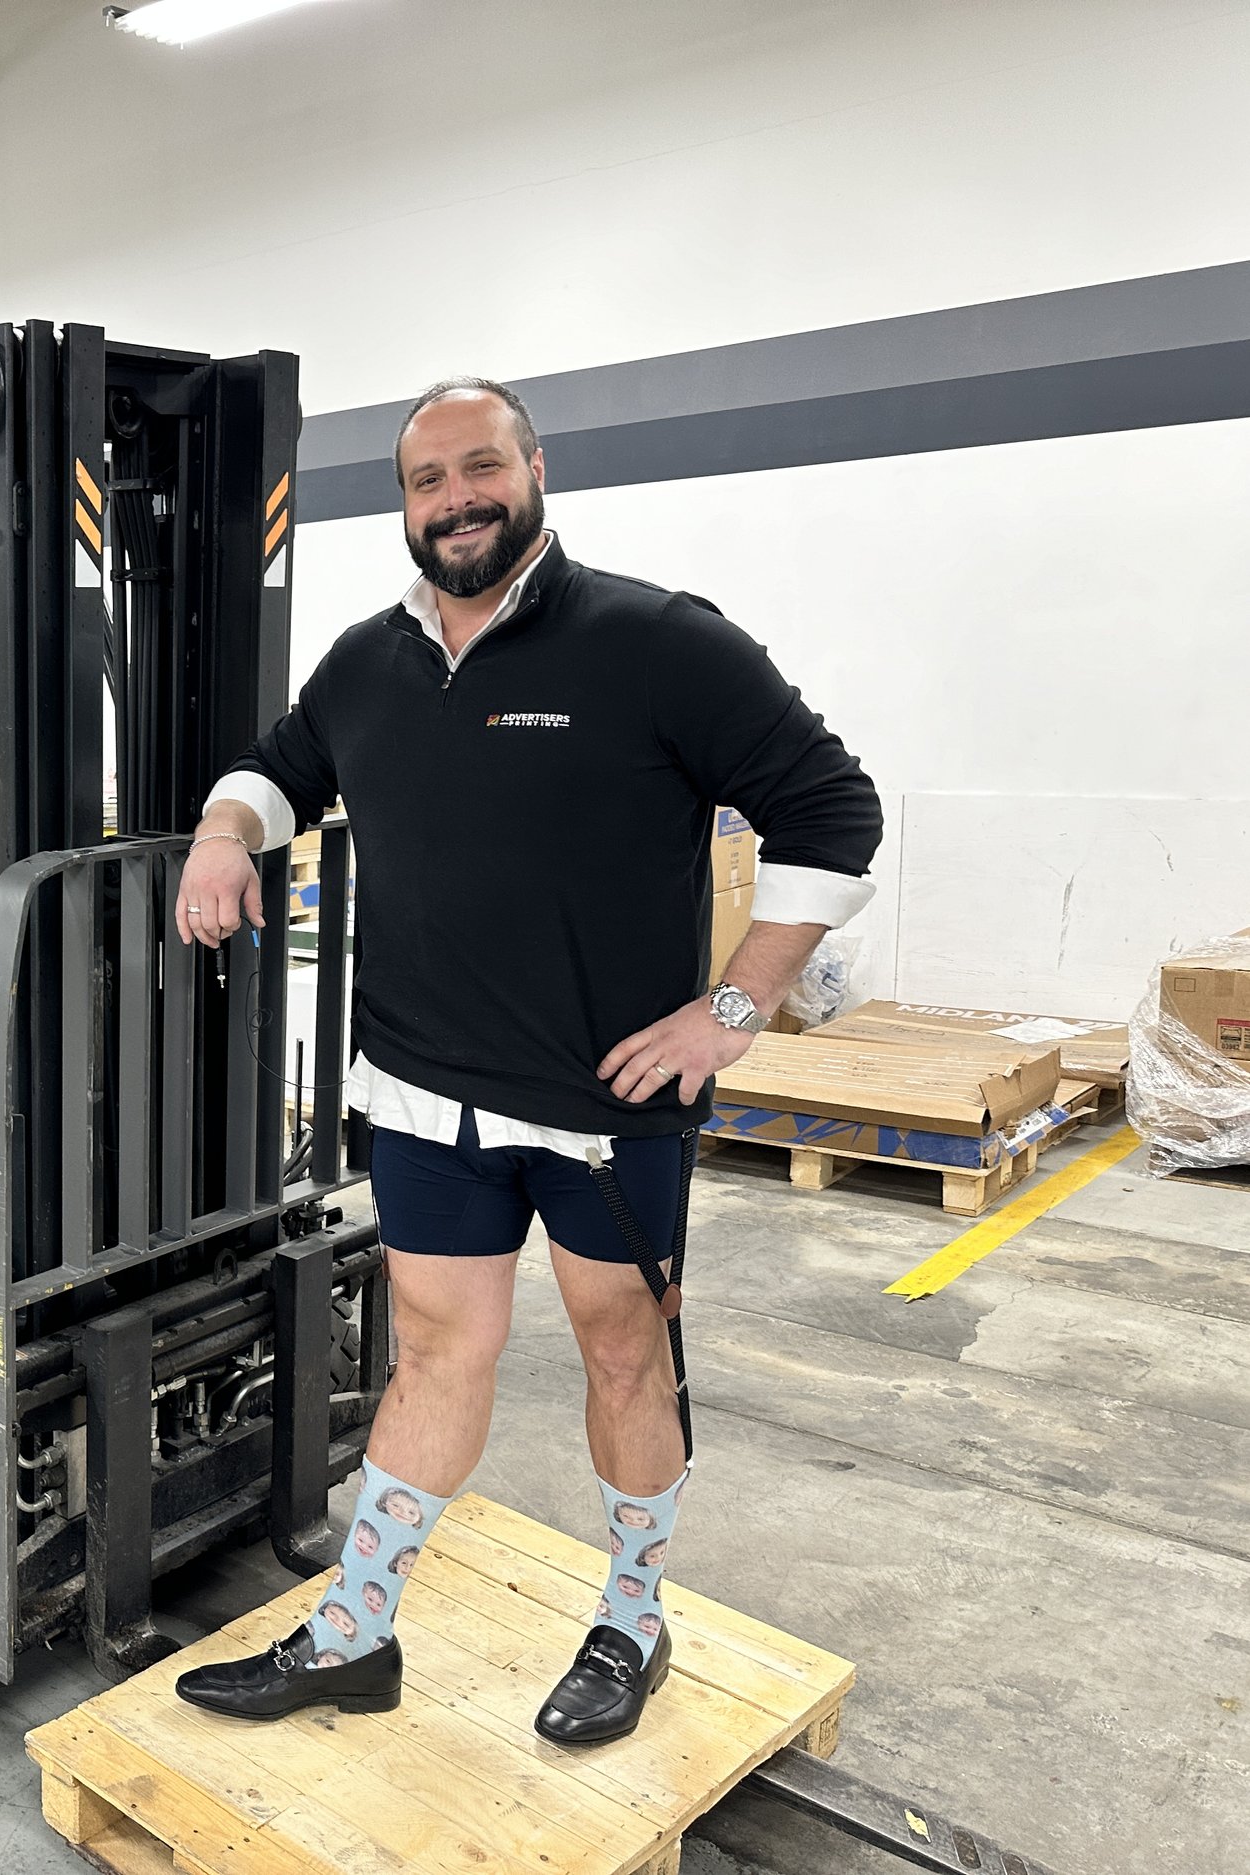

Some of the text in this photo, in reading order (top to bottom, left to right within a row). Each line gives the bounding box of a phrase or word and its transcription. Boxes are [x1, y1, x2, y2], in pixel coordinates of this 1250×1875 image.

[501, 713, 570, 724] ADVERTISERS
[508, 720, 559, 728] PRINTING
[894, 1004, 1055, 1024] MIDLAN
